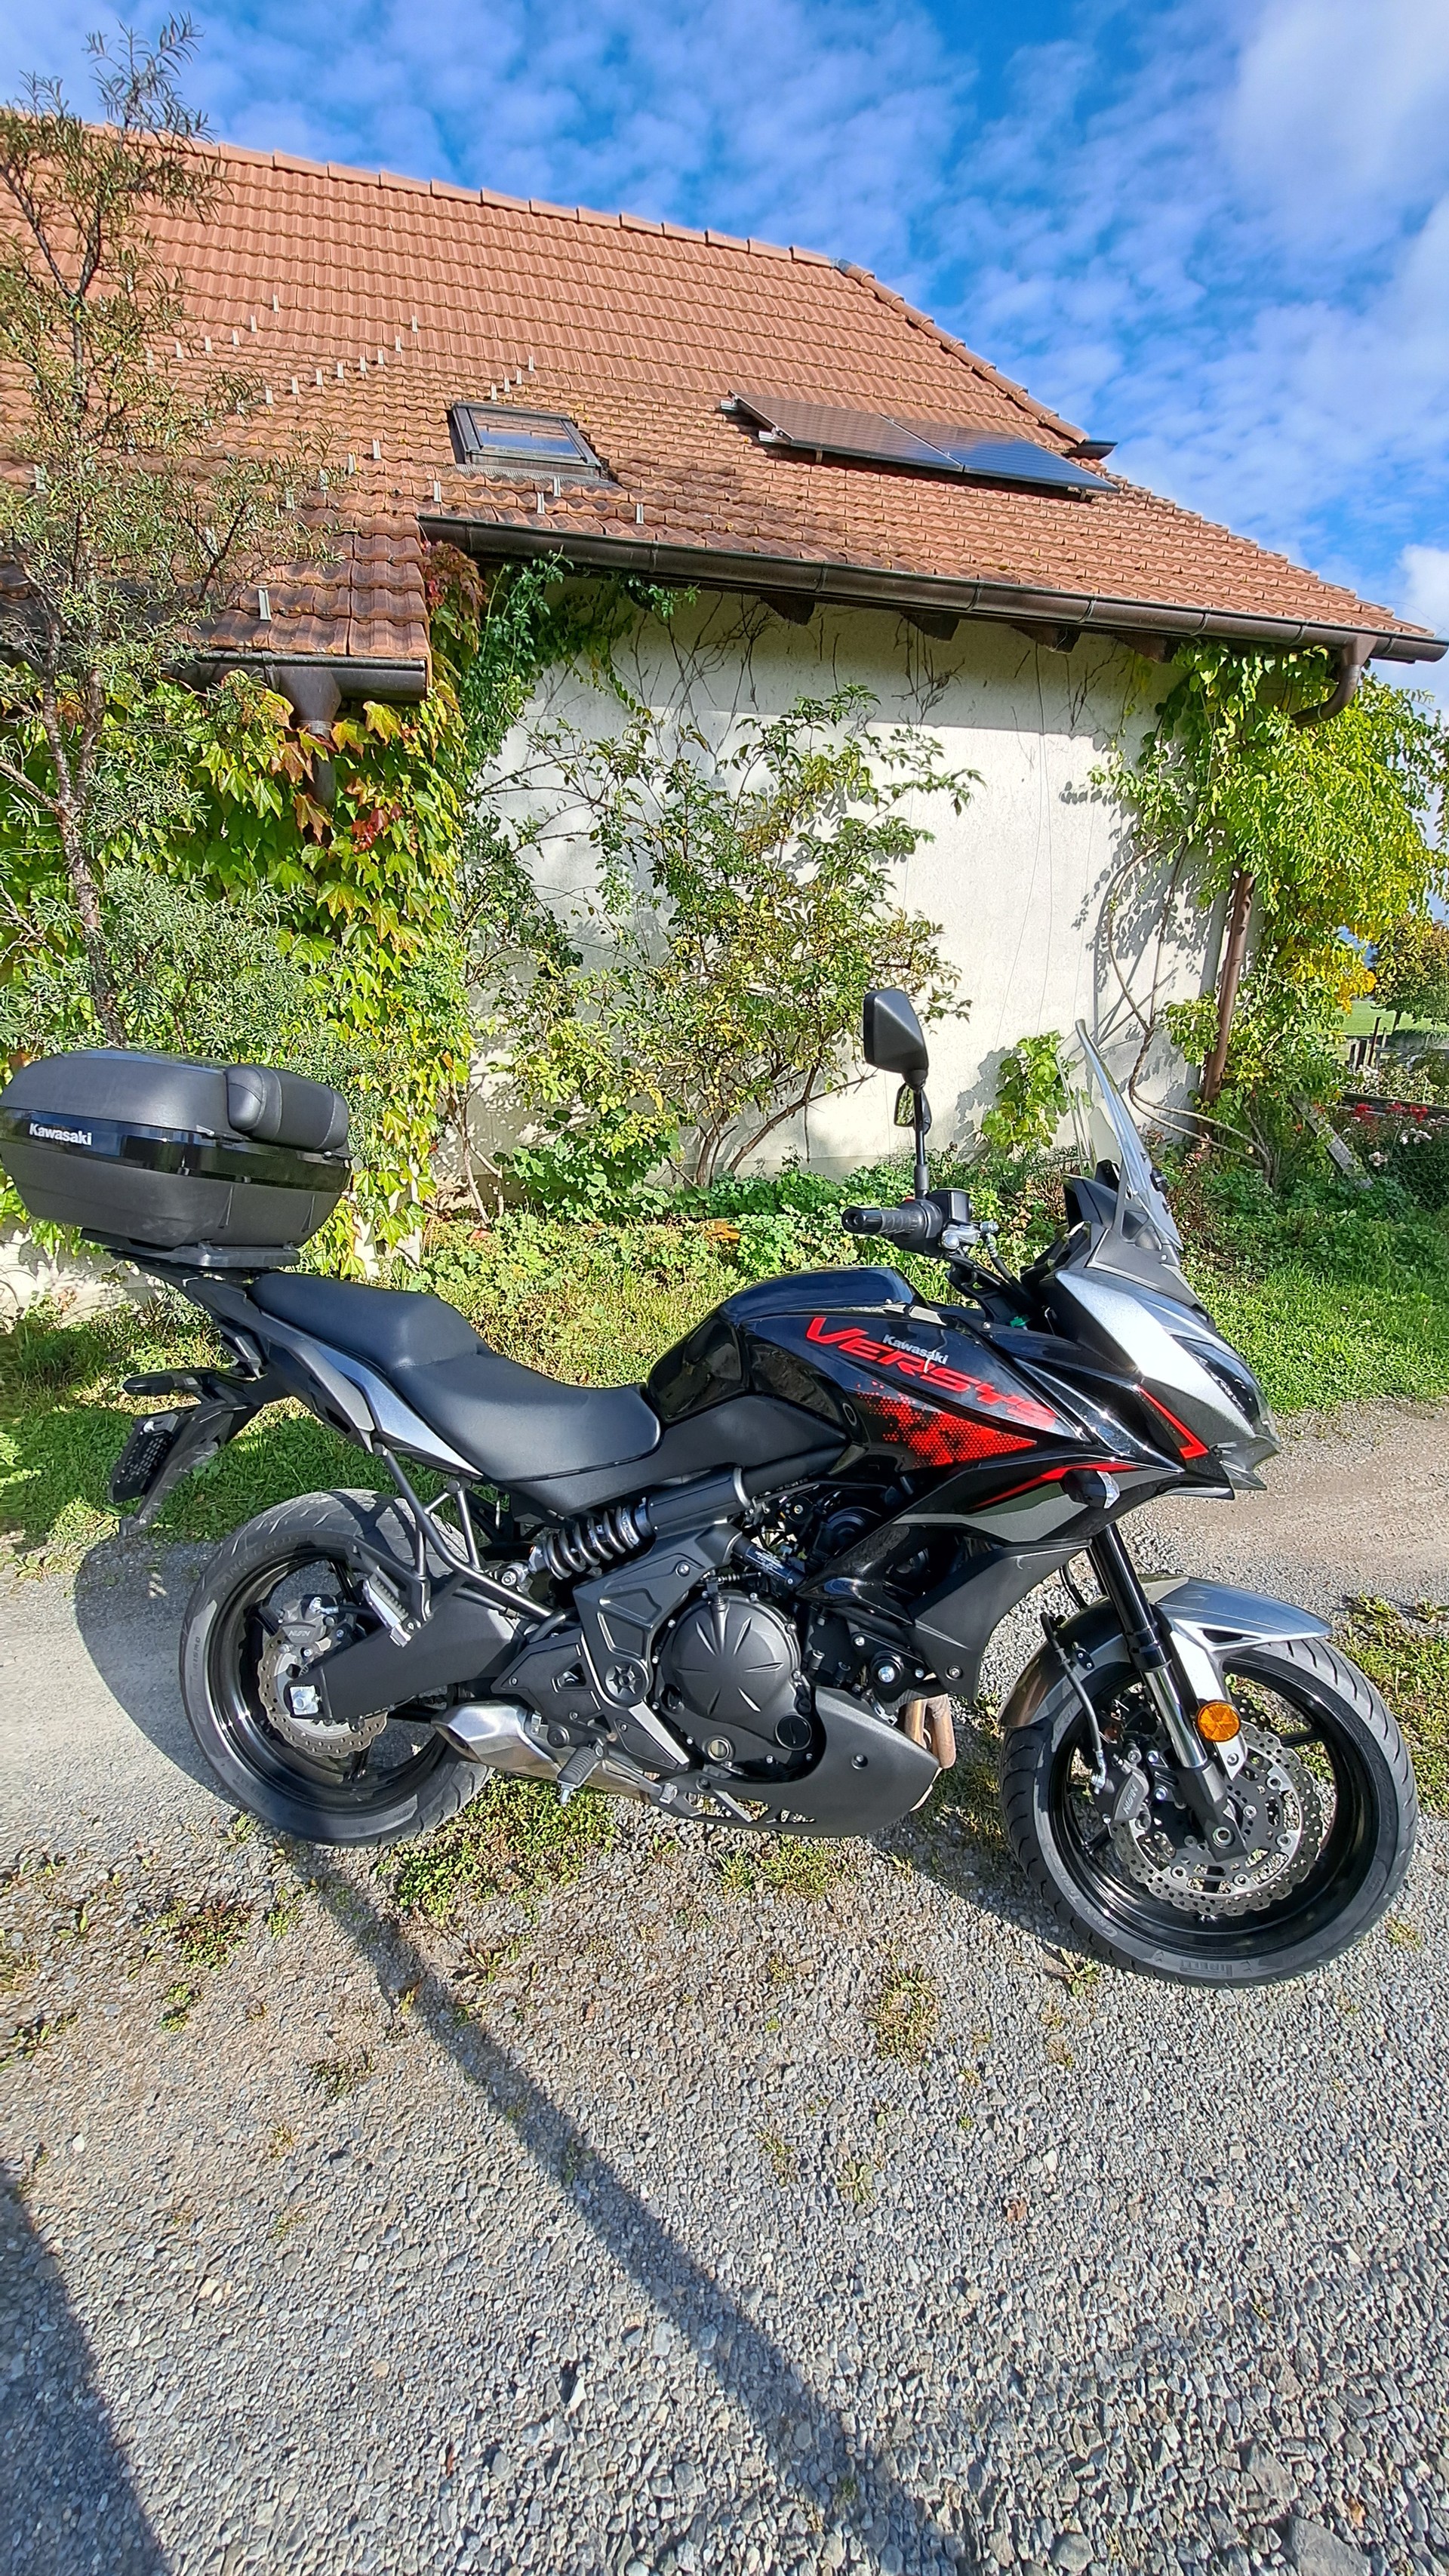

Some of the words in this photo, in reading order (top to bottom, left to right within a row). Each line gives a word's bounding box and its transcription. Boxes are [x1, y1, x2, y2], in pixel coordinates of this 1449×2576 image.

[29, 1122, 92, 1146] Kawasaki
[882, 1334, 949, 1365] Kawasaki
[805, 1316, 1058, 1429] VERSYS
